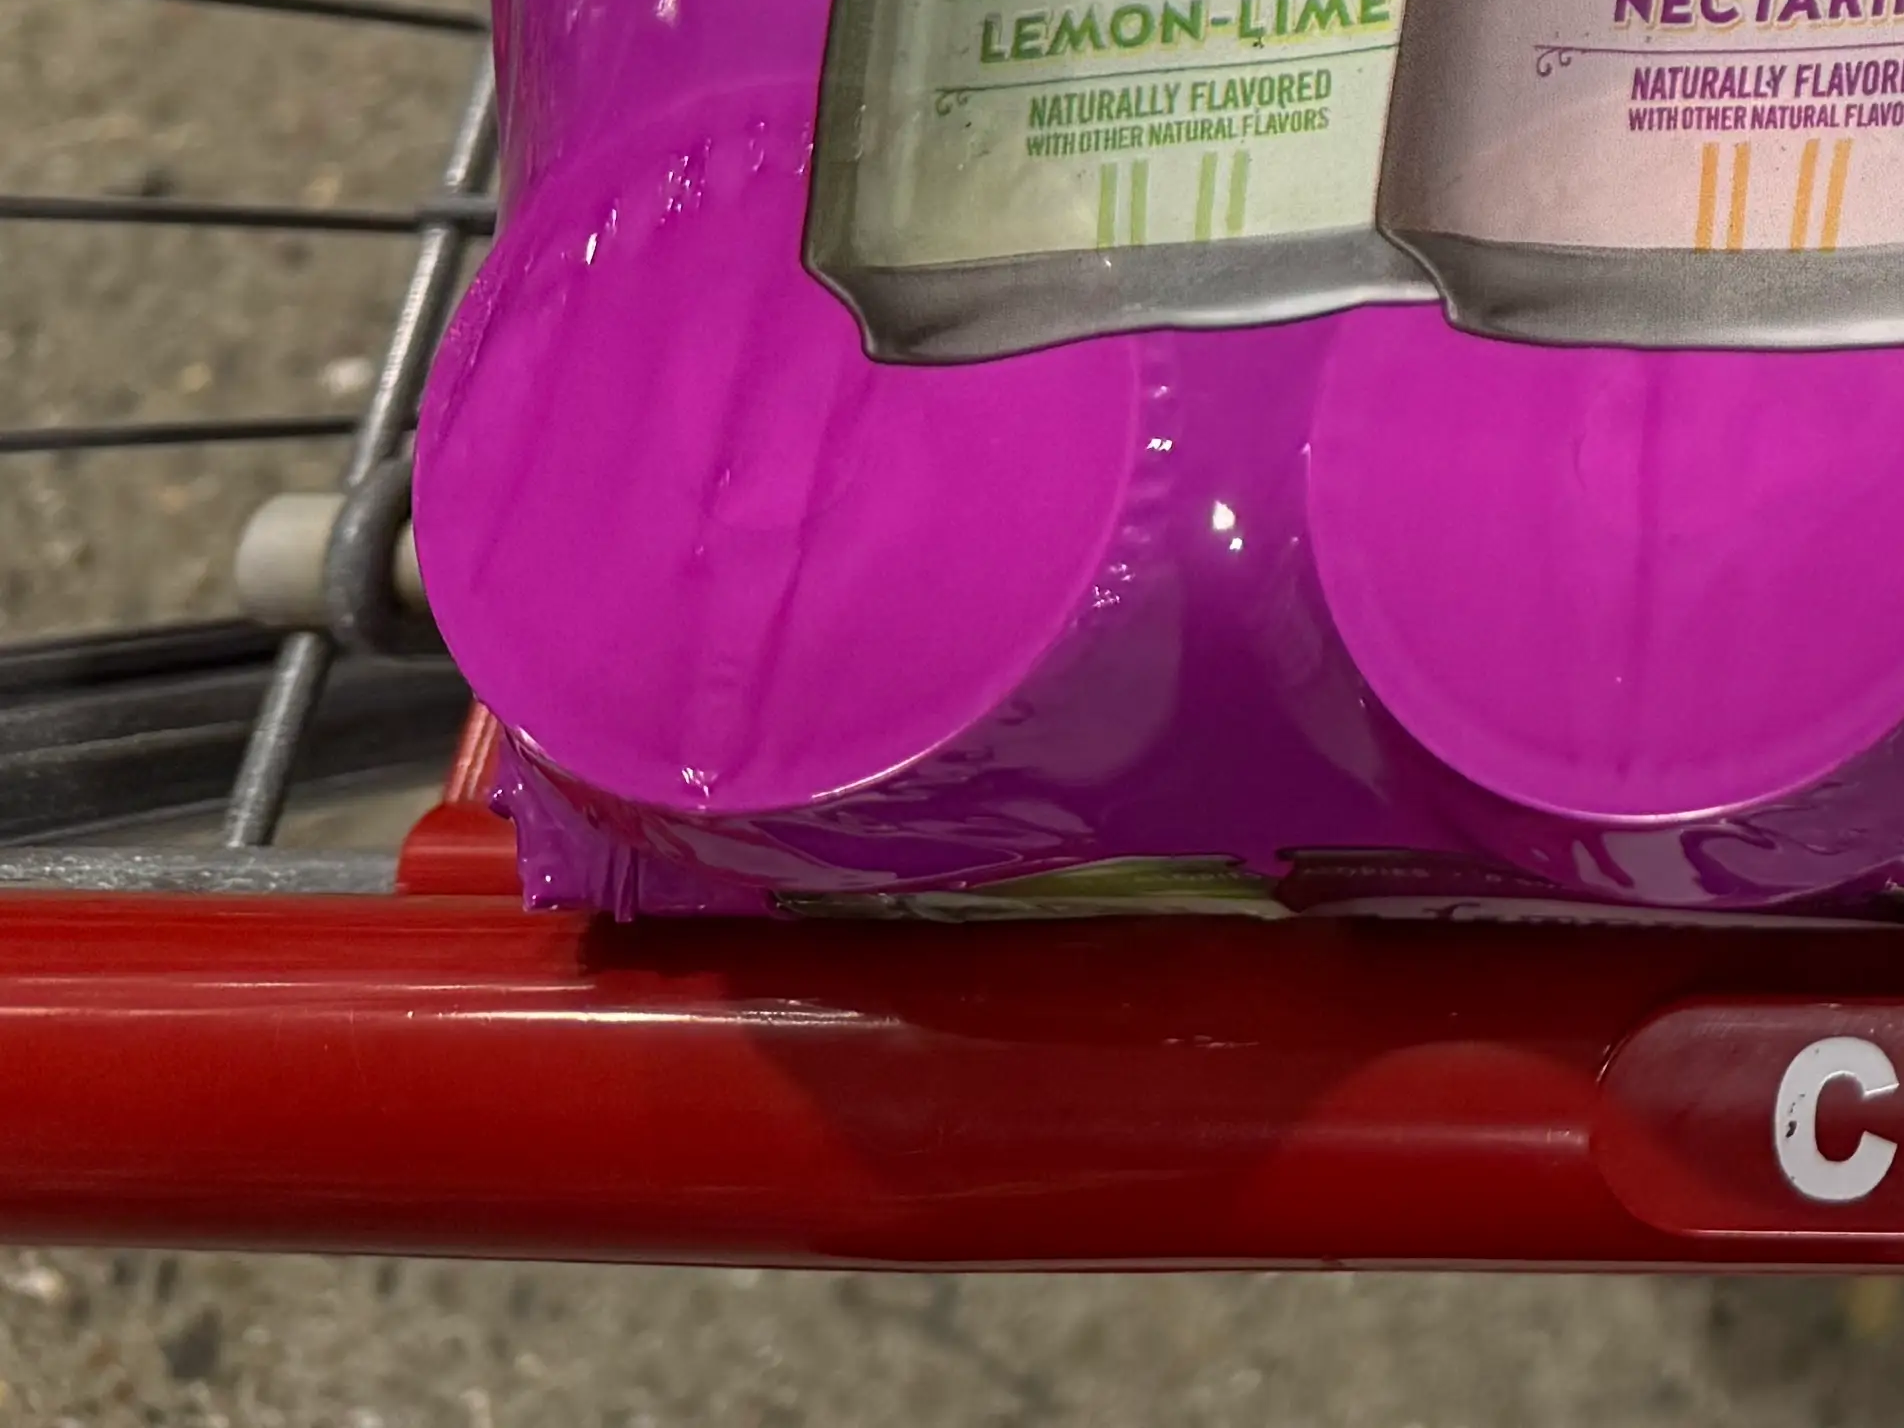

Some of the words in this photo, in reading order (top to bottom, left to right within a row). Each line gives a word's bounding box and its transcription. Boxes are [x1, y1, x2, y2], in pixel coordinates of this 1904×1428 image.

[1027, 82, 1181, 129] NATURALLY
[1190, 68, 1333, 111] FLAVORED
[1631, 64, 1786, 102] NATURALLY
[1078, 121, 1144, 155] OTHER
[1148, 116, 1236, 147] NATURAL
[1243, 106, 1330, 143] FLAVORS
[1628, 106, 1680, 131] WITH
[1680, 105, 1748, 131] OTHER
[1751, 103, 1840, 130] NATURAL
